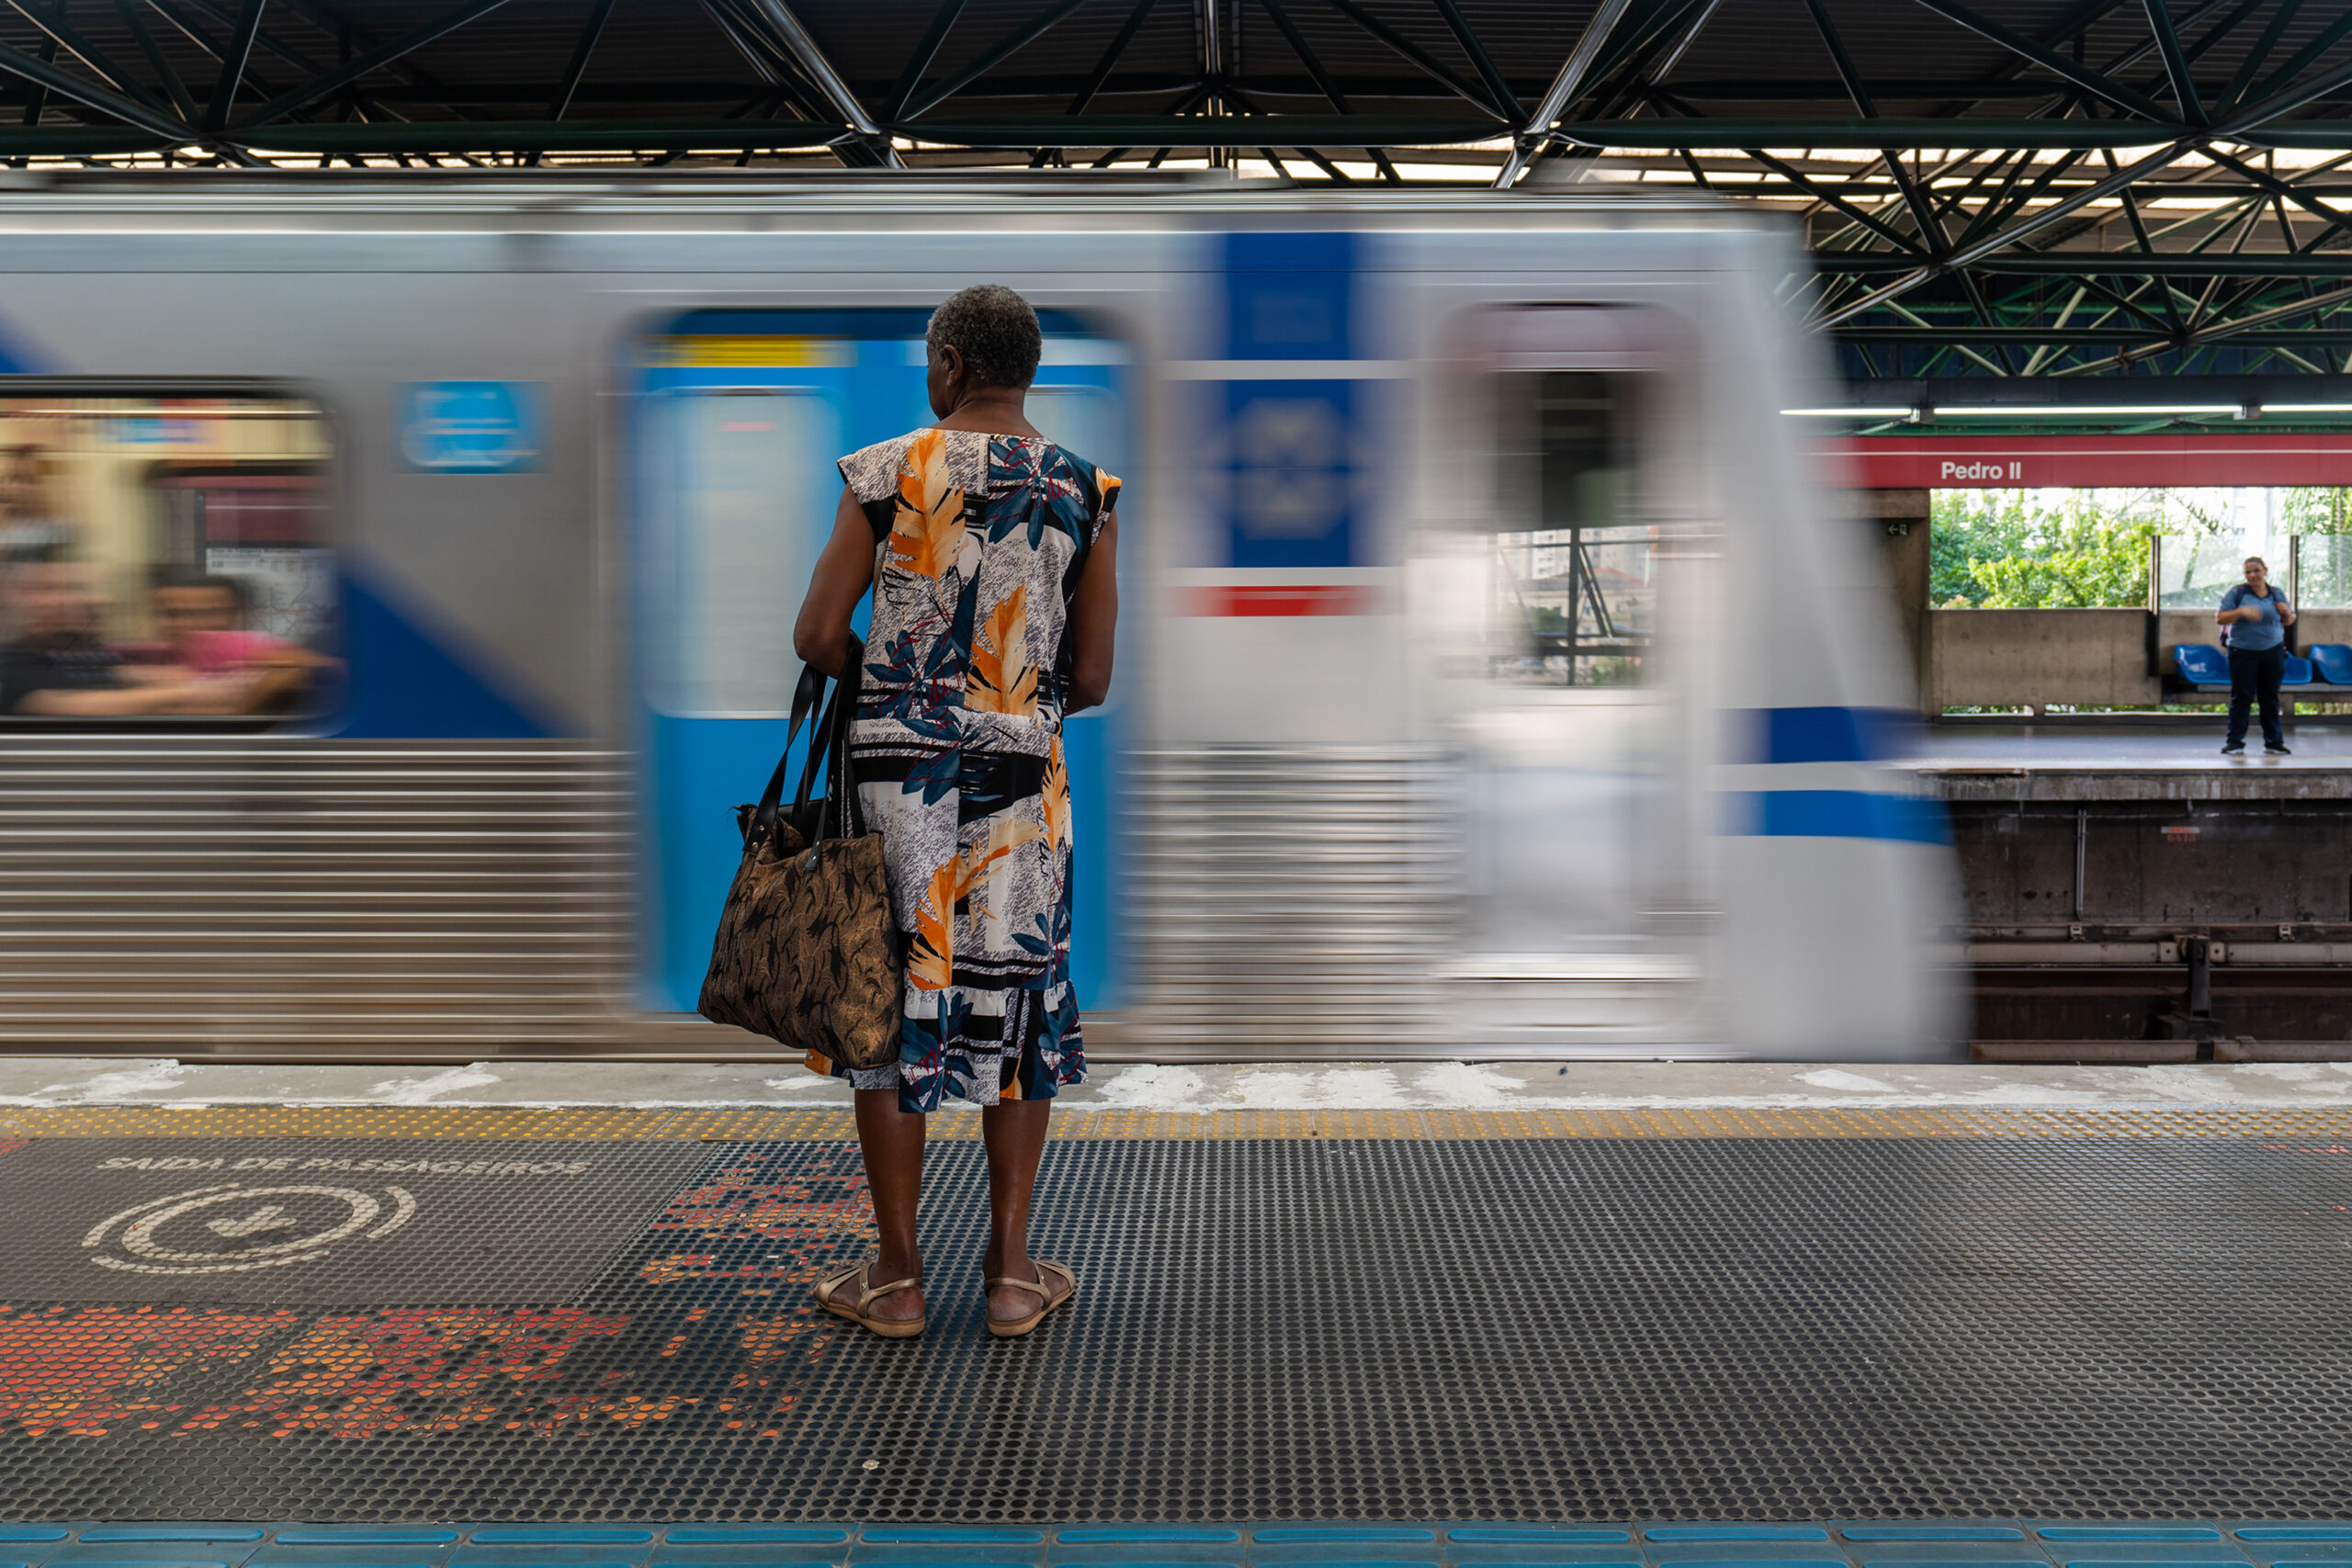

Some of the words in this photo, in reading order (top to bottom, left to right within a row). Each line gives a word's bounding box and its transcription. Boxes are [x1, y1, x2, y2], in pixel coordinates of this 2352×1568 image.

[1941, 461, 2003, 479] Pedro
[2009, 461, 2021, 479] II
[230, 1157, 297, 1169] DE
[297, 1157, 591, 1175] PASSAGEIROS
